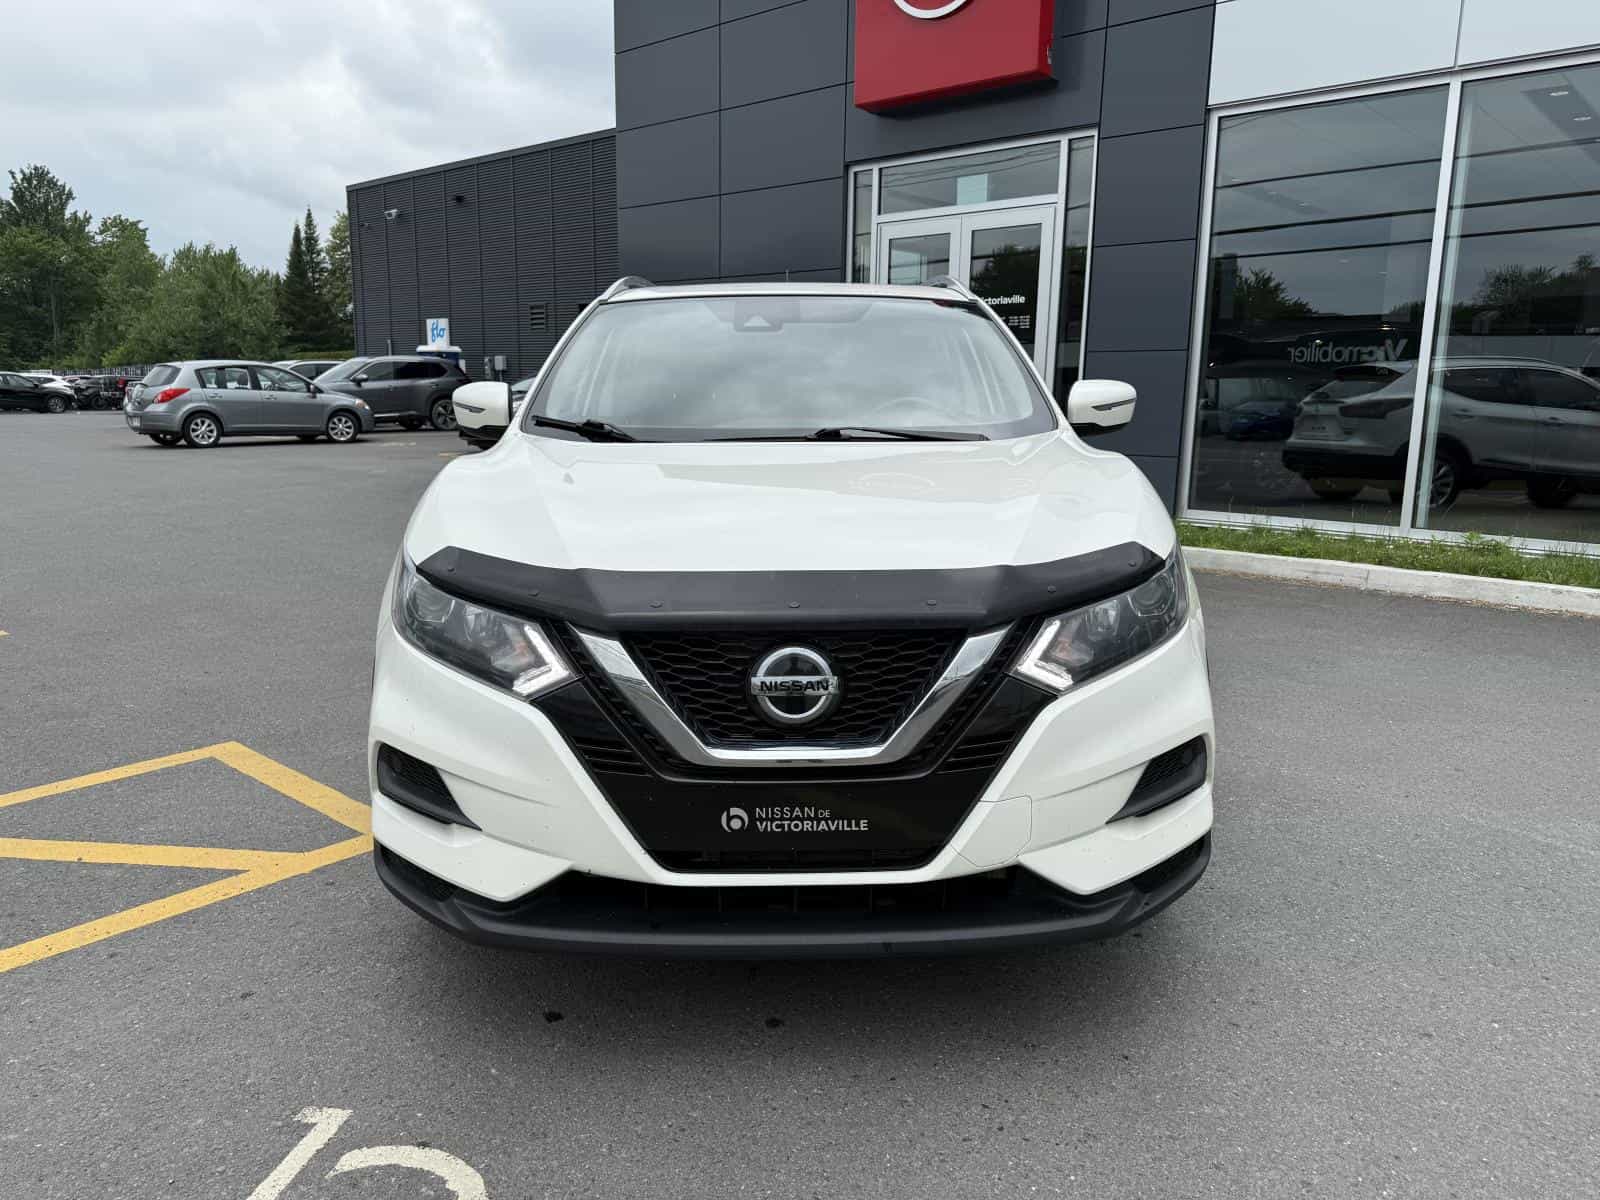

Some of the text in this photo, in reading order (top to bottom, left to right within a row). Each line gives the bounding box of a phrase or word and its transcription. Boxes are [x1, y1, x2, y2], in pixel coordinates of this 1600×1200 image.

[981, 294, 1026, 305] ictoriaville
[431, 319, 446, 343] flo
[760, 680, 830, 692] NISSAN
[755, 806, 831, 818] NISSAN DE
[756, 819, 869, 832] VICTORIAVILLE
